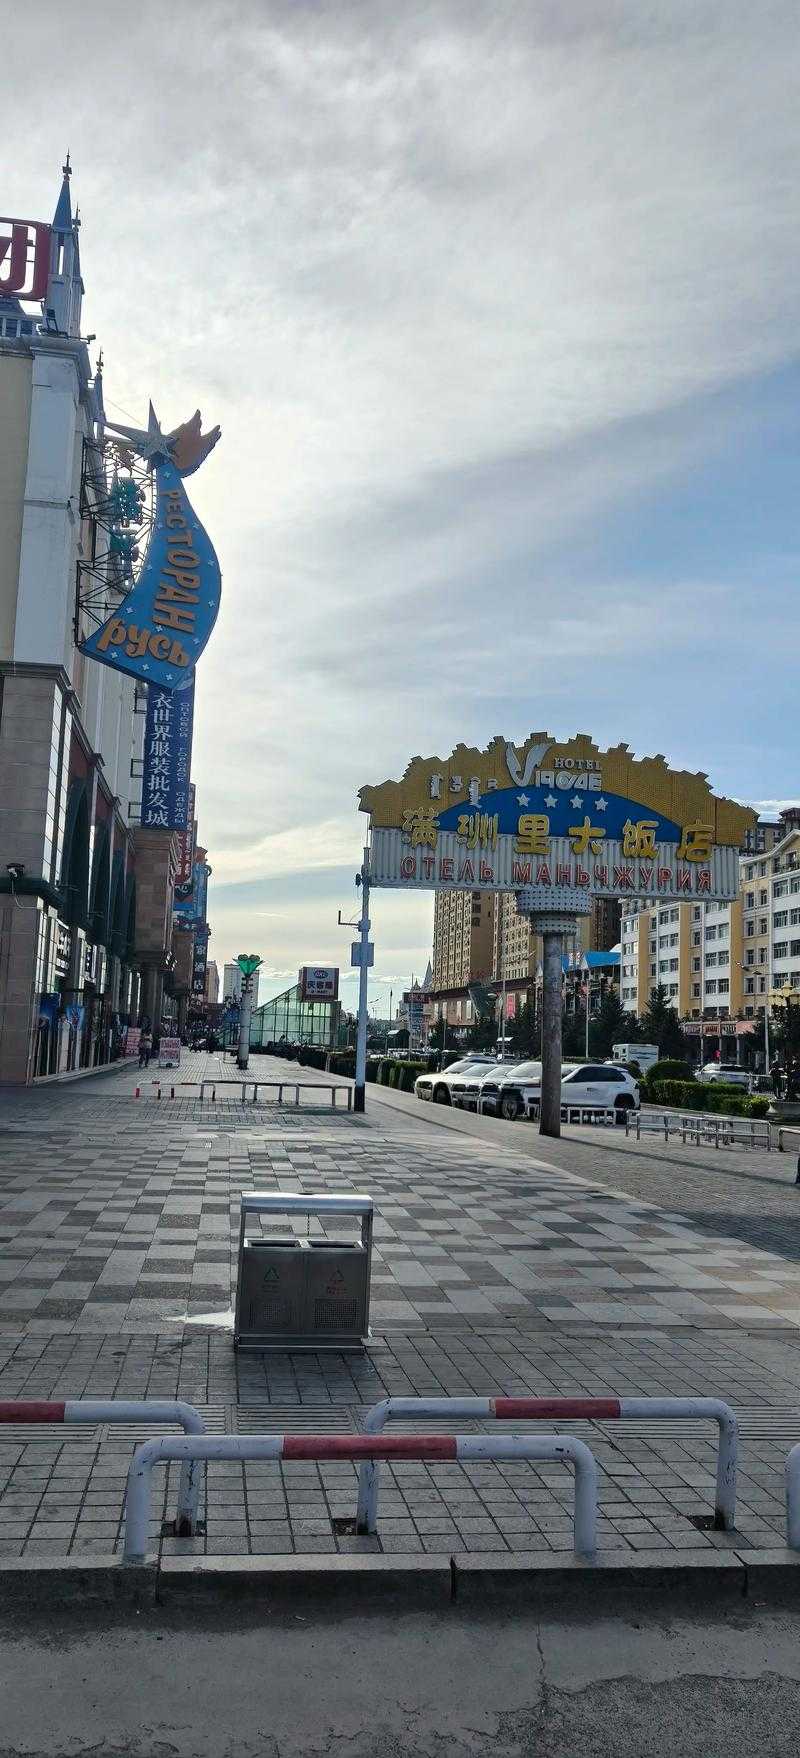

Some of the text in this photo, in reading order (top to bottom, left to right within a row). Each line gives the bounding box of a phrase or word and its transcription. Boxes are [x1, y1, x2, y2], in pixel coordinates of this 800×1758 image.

[153, 489, 201, 634] РЕСТОРАН
[554, 757, 602, 771] HOTEL
[401, 855, 713, 890] ОТЕЛЬ МАНЬЧЖУРИЯ
